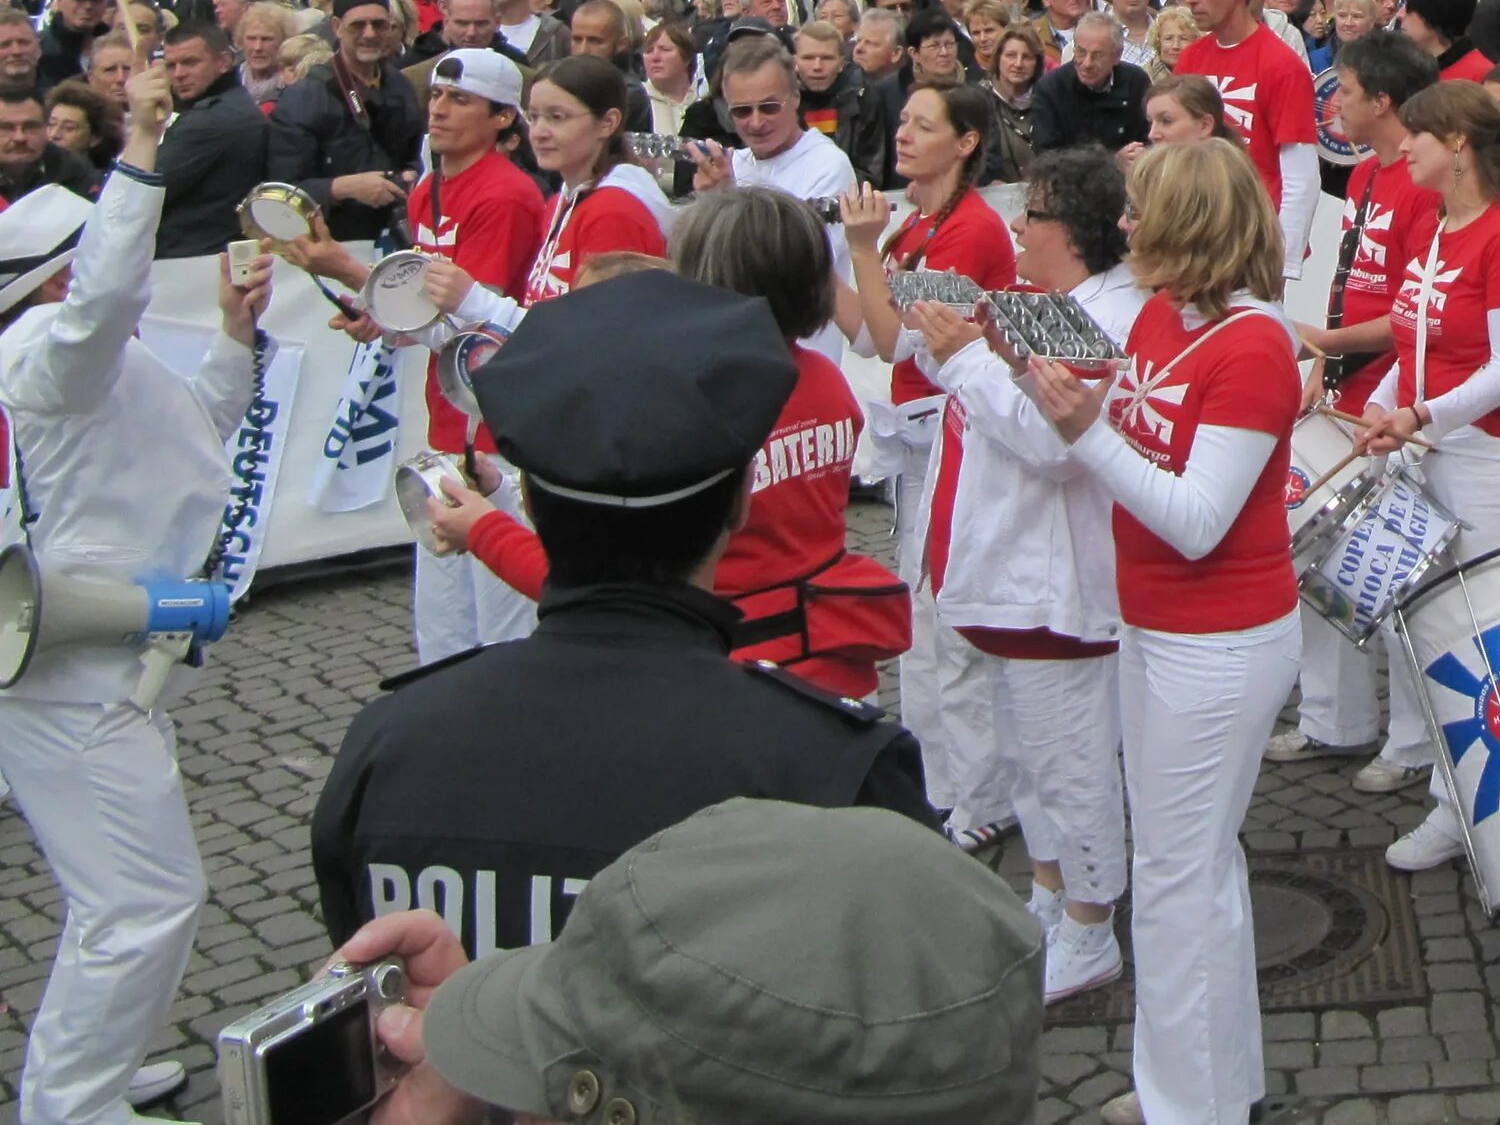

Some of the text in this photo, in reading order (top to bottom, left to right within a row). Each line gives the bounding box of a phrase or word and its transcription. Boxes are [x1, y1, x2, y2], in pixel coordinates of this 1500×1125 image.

[1384, 503, 1406, 534] DE
[1478, 684, 1489, 719] UNIDOS
[368, 863, 591, 962] POLI
